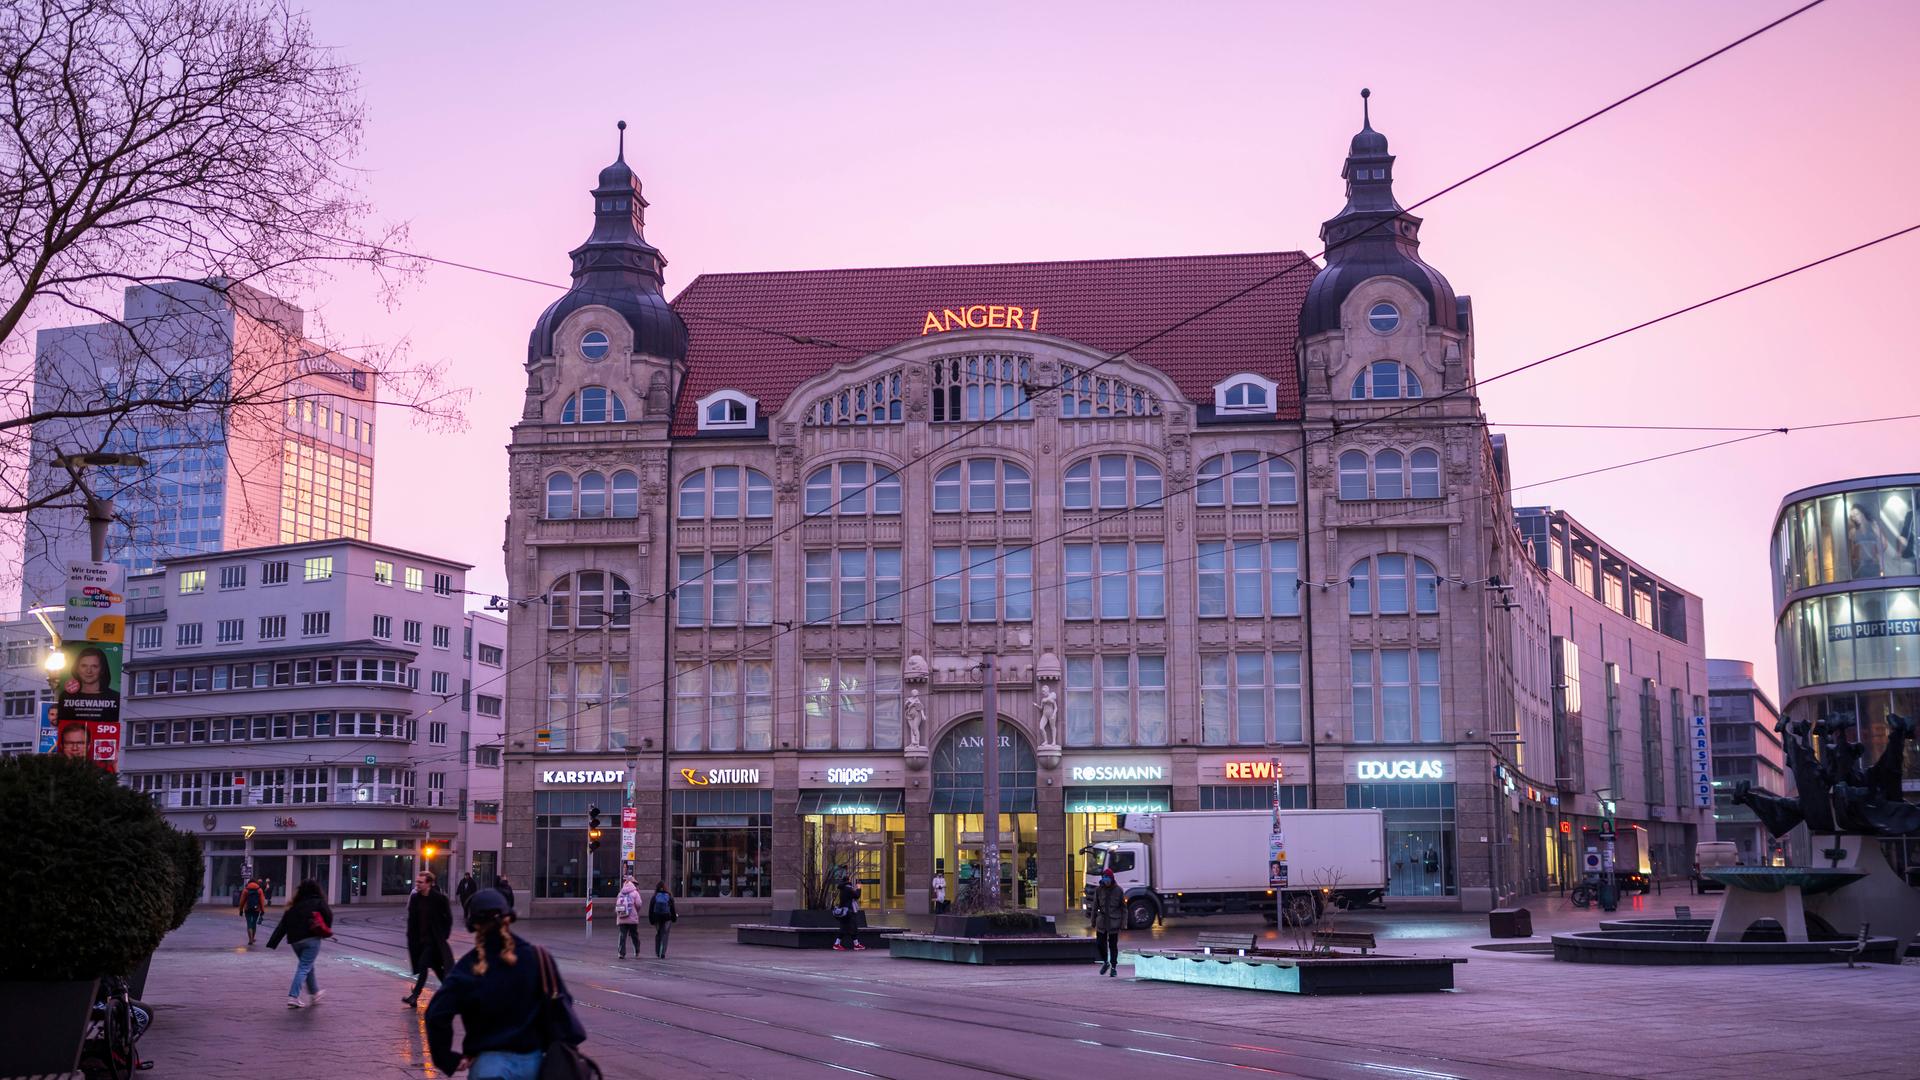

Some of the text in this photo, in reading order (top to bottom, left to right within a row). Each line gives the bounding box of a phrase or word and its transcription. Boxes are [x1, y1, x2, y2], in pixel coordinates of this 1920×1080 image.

[922, 305, 1039, 335] ANGER 1
[1835, 621, 1920, 638] PUMPUPTHEGY
[64, 700, 117, 708] ZUGEWANDT.
[97, 725, 117, 734] SPD
[959, 736, 1010, 747] ANR
[1696, 717, 1708, 805] KARSTADT
[543, 771, 624, 783] KARSTADT
[709, 769, 759, 784] SATURN
[1073, 766, 1162, 780] ROSSMANN
[1225, 762, 1283, 778] REWE
[1358, 760, 1443, 779] DOUGLAS
